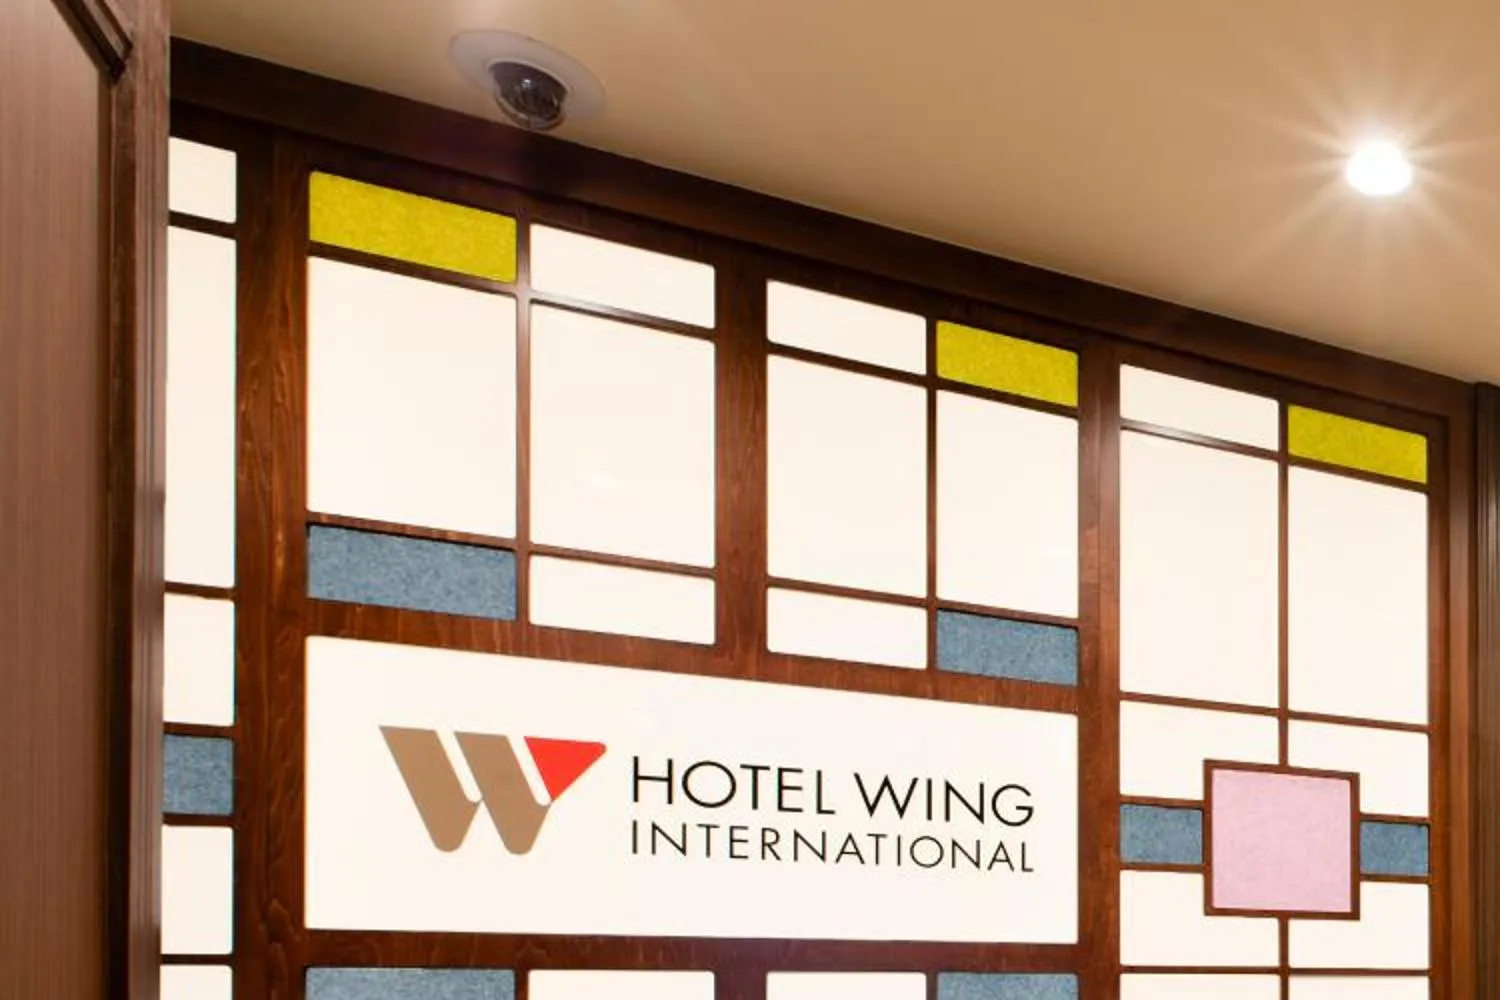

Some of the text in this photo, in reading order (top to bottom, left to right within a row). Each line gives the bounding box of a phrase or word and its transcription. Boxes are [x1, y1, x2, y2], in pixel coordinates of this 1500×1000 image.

[632, 755, 1035, 828] HOTEL WING
[631, 819, 1034, 873] INTERNATIONAL
